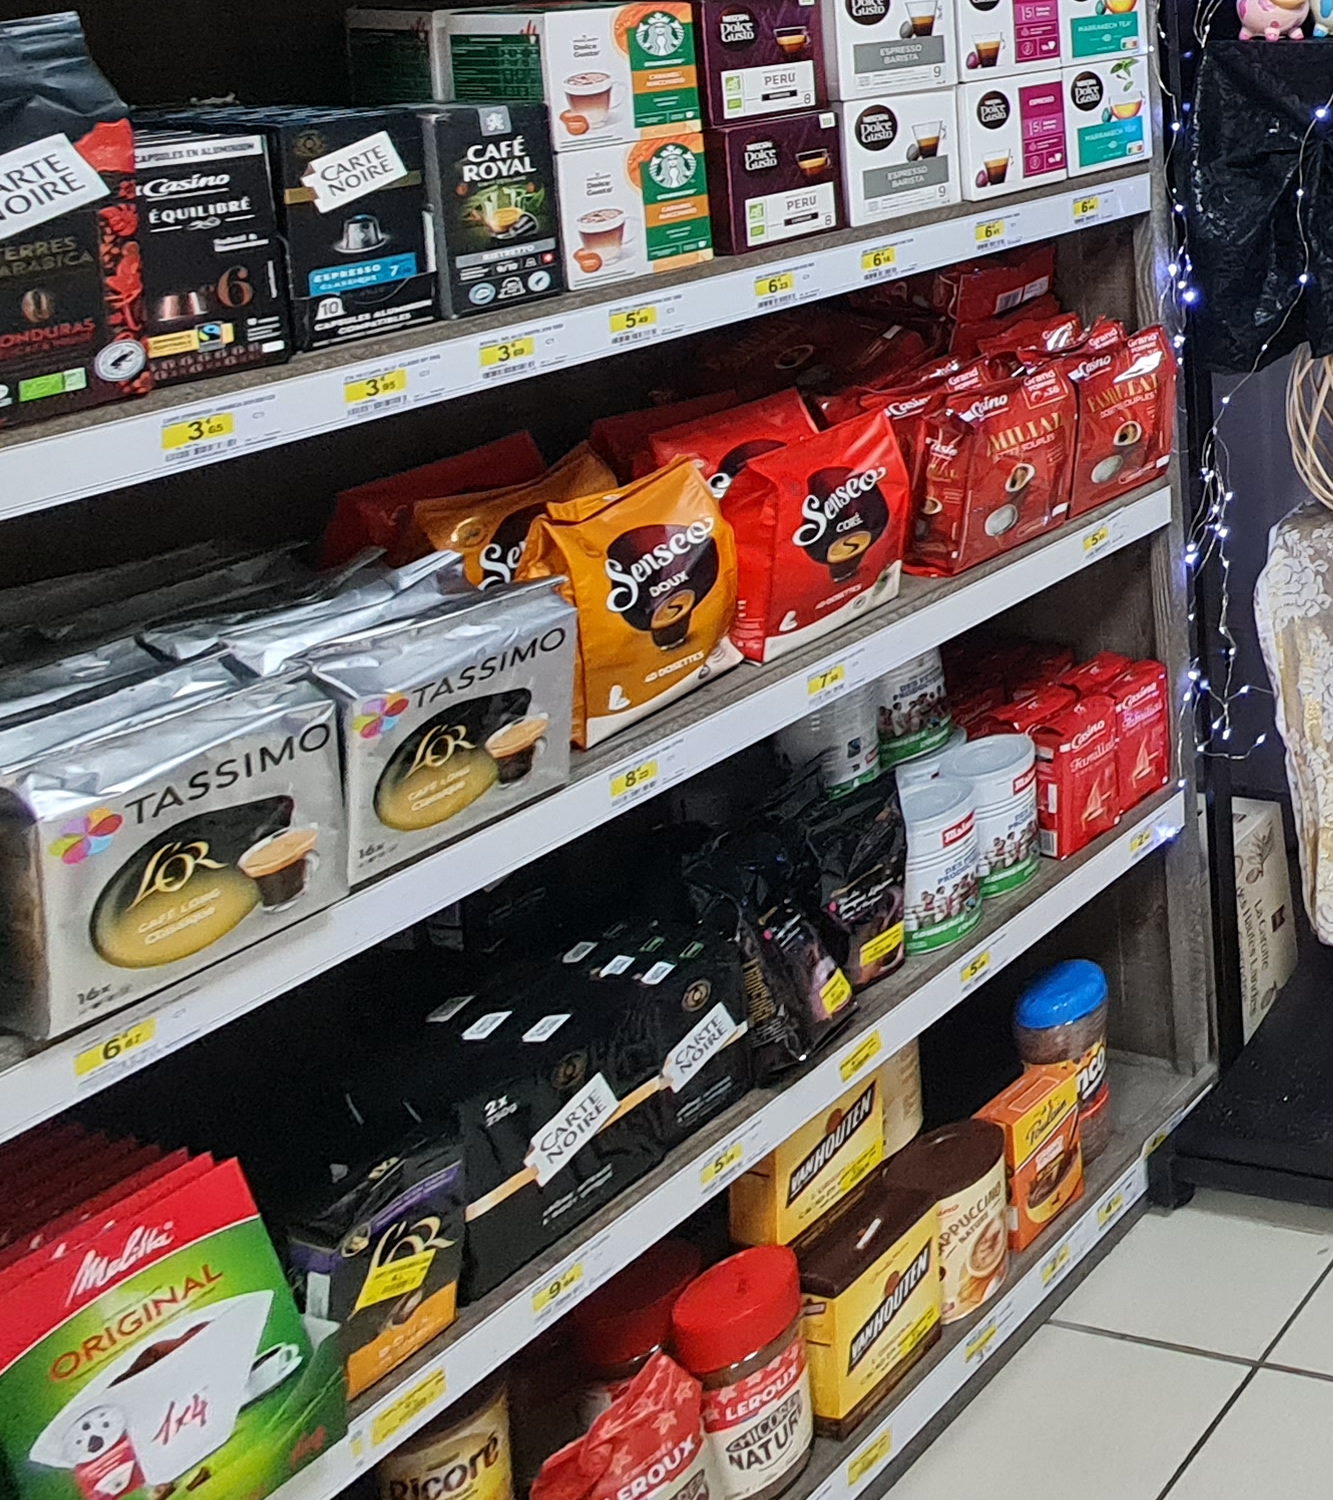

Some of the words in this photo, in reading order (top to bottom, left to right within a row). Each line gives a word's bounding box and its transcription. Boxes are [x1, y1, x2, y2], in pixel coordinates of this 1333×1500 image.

[852, 4, 886, 18] Gusto
[720, 20, 754, 34] Dolce
[721, 30, 756, 44] Gusto
[764, 71, 797, 87] PERU
[933, 65, 943, 79] 9
[804, 92, 812, 105] 8
[860, 121, 892, 135] Dolce
[861, 130, 894, 144] Gusto
[320, 145, 388, 182] CARTE
[467, 135, 527, 163] CAFÉ
[744, 147, 777, 163] Dolce
[328, 158, 395, 197] NOIRE
[462, 156, 537, 183] ROYAL
[745, 157, 779, 172] Gusto
[143, 173, 231, 198] Casino
[938, 185, 948, 199] 9
[149, 196, 252, 224] ÉQUILIBRÉ
[786, 194, 818, 212] PERU
[824, 214, 833, 227] 8
[217, 265, 254, 309] 6
[313, 263, 382, 284] ESPRESSO
[389, 265, 400, 278] 7
[314, 312, 372, 332] CAPSULES
[321, 301, 340, 316] 10
[792, 466, 888, 547] Senseo
[604, 516, 715, 614] Senseo
[648, 570, 691, 599] DOUX
[411, 627, 567, 709] TASSIMO
[1124, 682, 1158, 711] Casino
[1071, 719, 1106, 750] Casino
[405, 723, 478, 780] L'OR
[125, 722, 331, 825] TASSIMO
[127, 839, 228, 912] L'OR
[672, 1013, 724, 1066] CARTE
[679, 1023, 728, 1075] NOIRE
[539, 1088, 602, 1153] CARTE
[546, 1101, 608, 1166] NOIRE
[790, 1157, 816, 1193] VAN
[811, 1087, 874, 1169] HOUTEN
[64, 1220, 175, 1310] Melitta
[850, 1316, 877, 1356] VAN
[872, 1245, 932, 1332] HOUTEN
[47, 1262, 225, 1384] ORIGINAL
[724, 1360, 800, 1422] LEROUX
